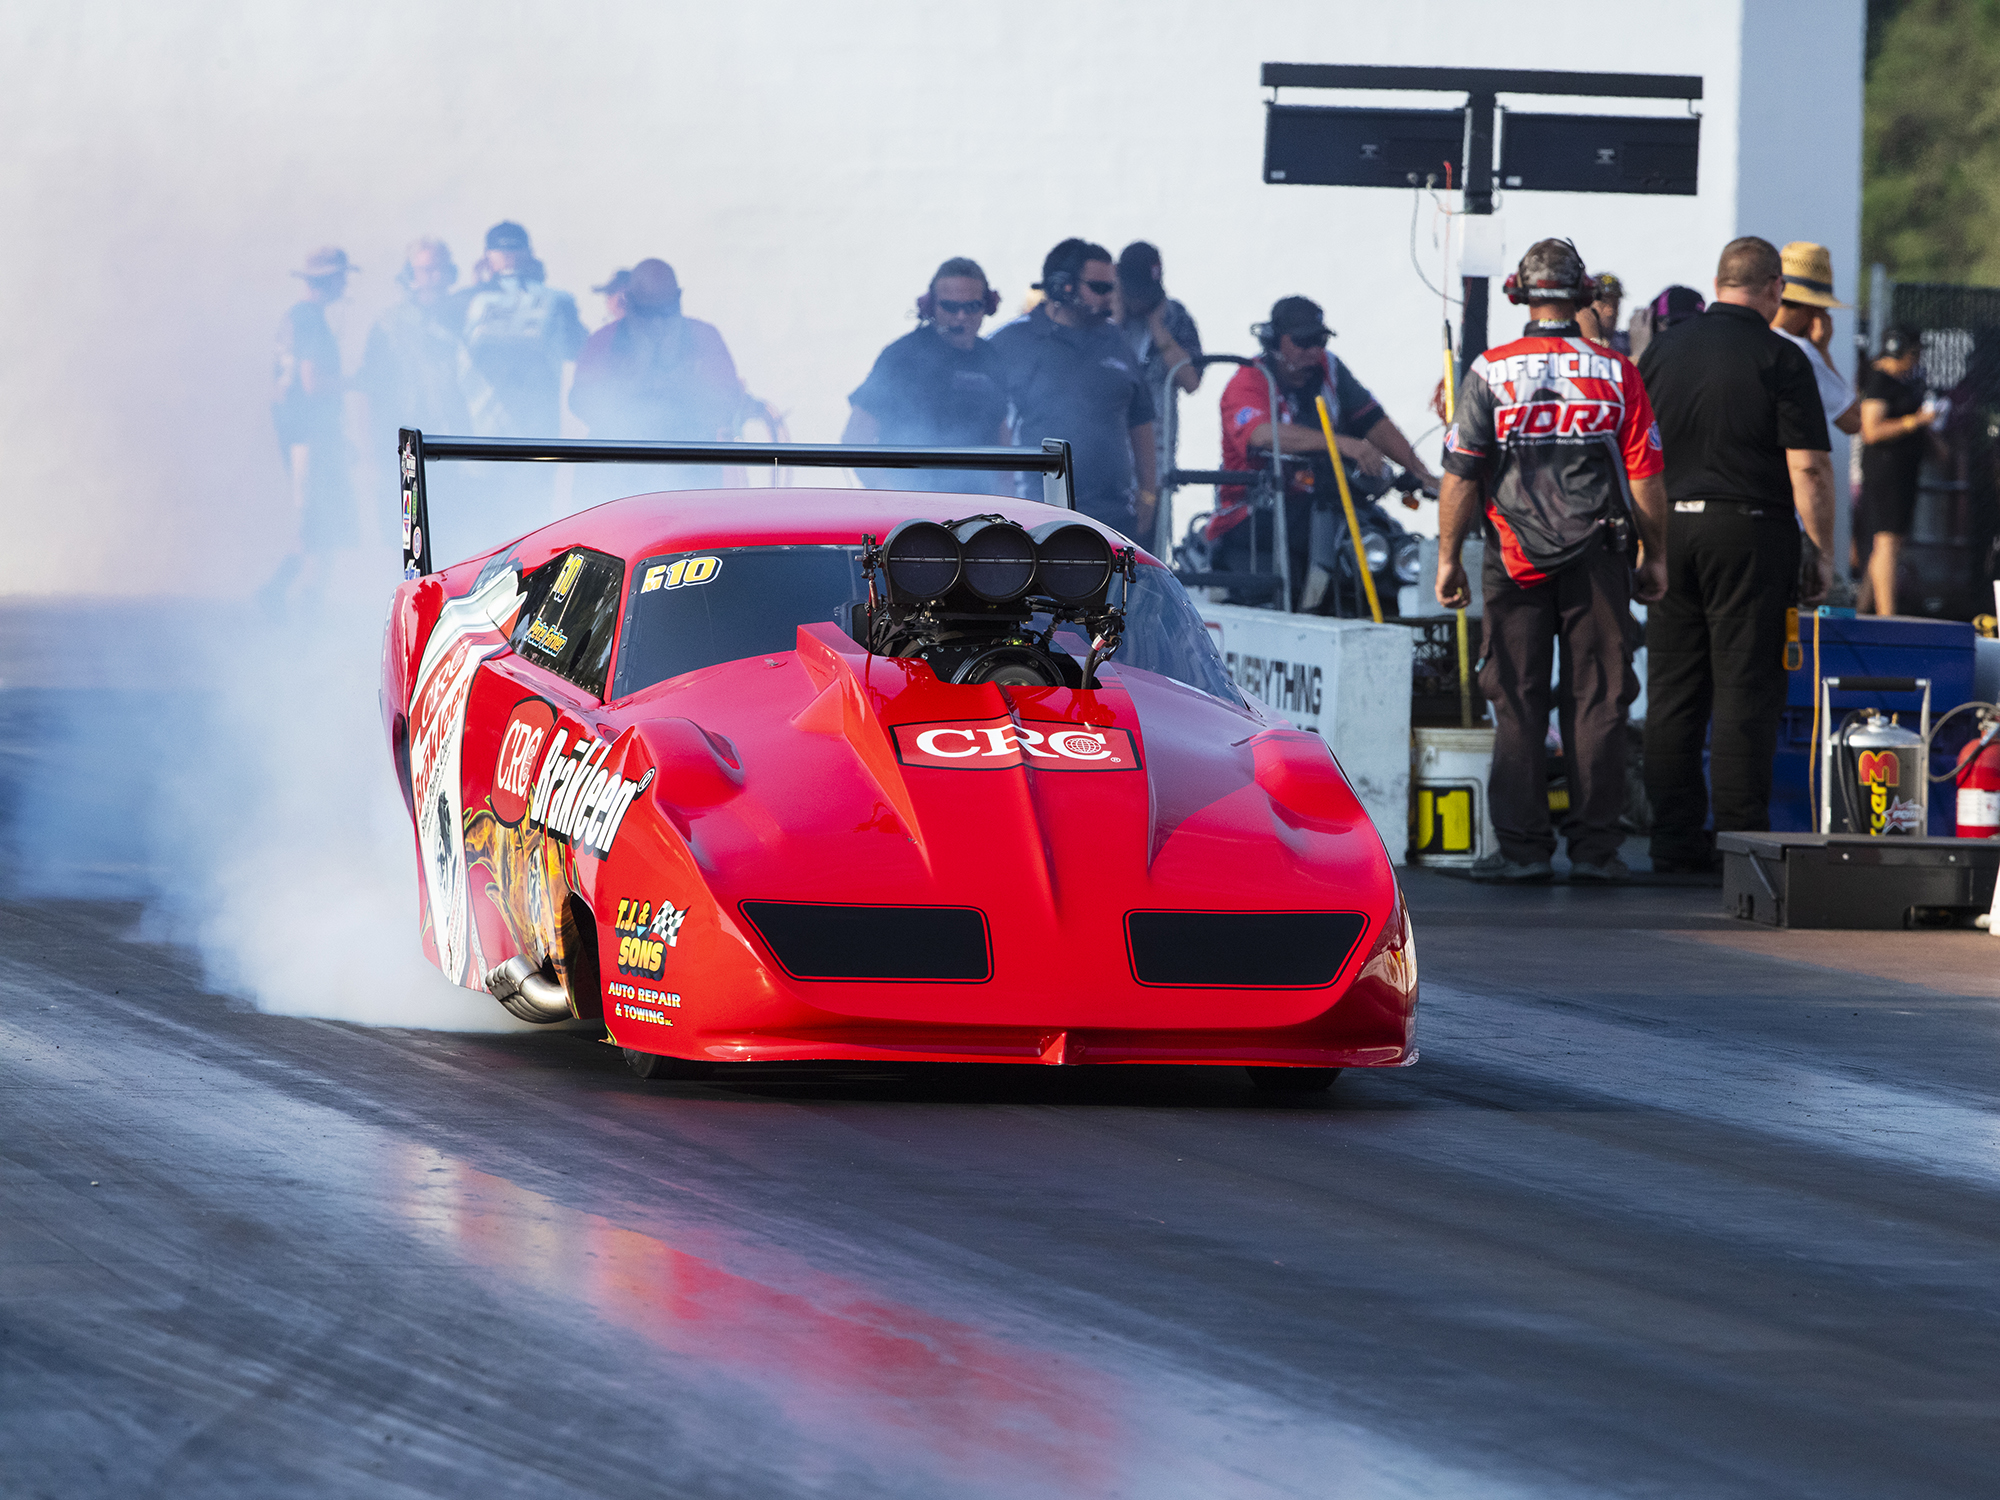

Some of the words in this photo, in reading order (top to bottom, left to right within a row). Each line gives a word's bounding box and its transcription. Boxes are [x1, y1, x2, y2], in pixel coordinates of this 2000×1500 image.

[664, 556, 723, 590] 10
[421, 638, 473, 729] CRC
[497, 719, 544, 801] CRC
[916, 724, 1112, 761] CRC
[615, 898, 640, 932] T.J.
[638, 900, 652, 925] &
[617, 935, 665, 973] SONS
[608, 982, 636, 1000] AUTO
[637, 986, 682, 1008] REPAIR
[615, 1002, 622, 1017] &
[623, 1004, 665, 1025] TOWING
